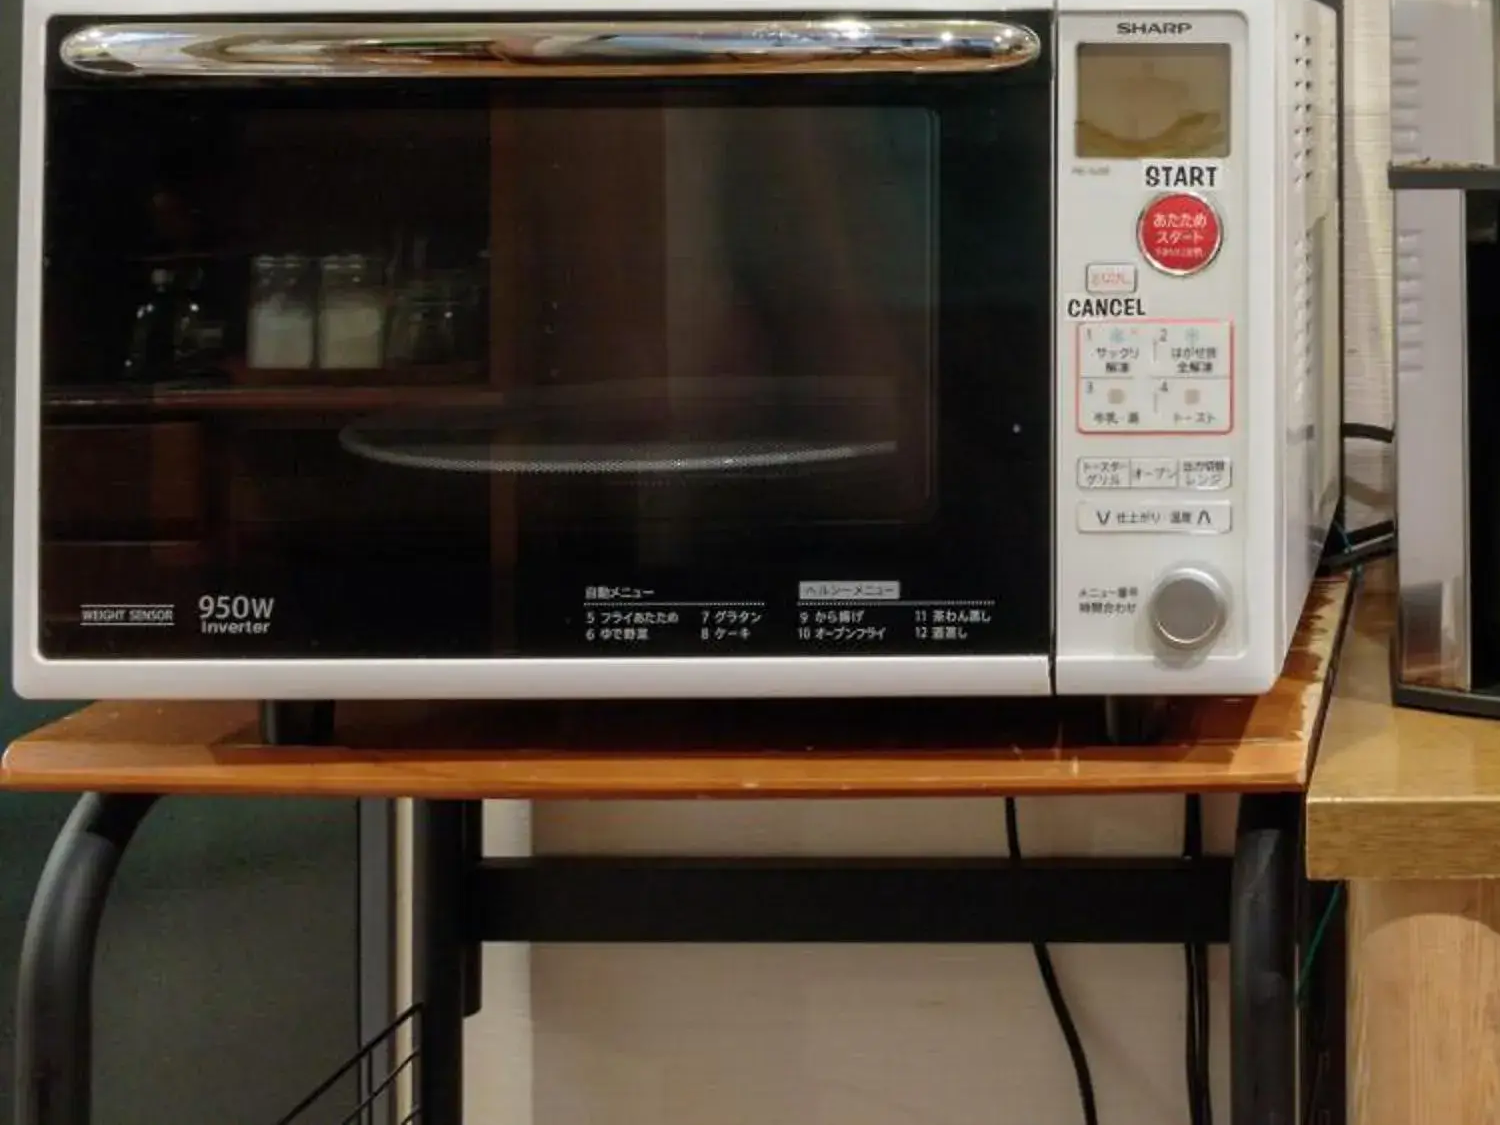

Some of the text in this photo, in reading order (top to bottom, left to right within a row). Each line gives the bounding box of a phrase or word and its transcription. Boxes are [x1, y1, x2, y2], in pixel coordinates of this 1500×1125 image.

[1116, 22, 1193, 35] SHARP
[1145, 166, 1217, 187] START
[1153, 212, 1207, 229] あたため
[1156, 230, 1204, 245] スタート
[1067, 298, 1146, 317] CANCEL
[805, 584, 895, 596] ヘルシーメニュー
[198, 595, 274, 619] 950W
[82, 609, 173, 622] WEIGHT SENSOR
[586, 611, 679, 624] 5 フライあたため
[702, 611, 711, 624] 7
[914, 609, 927, 623] 11
[586, 628, 595, 641] 6
[714, 627, 751, 641] ケーキ
[798, 626, 812, 640] 10
[914, 626, 928, 640] 12
